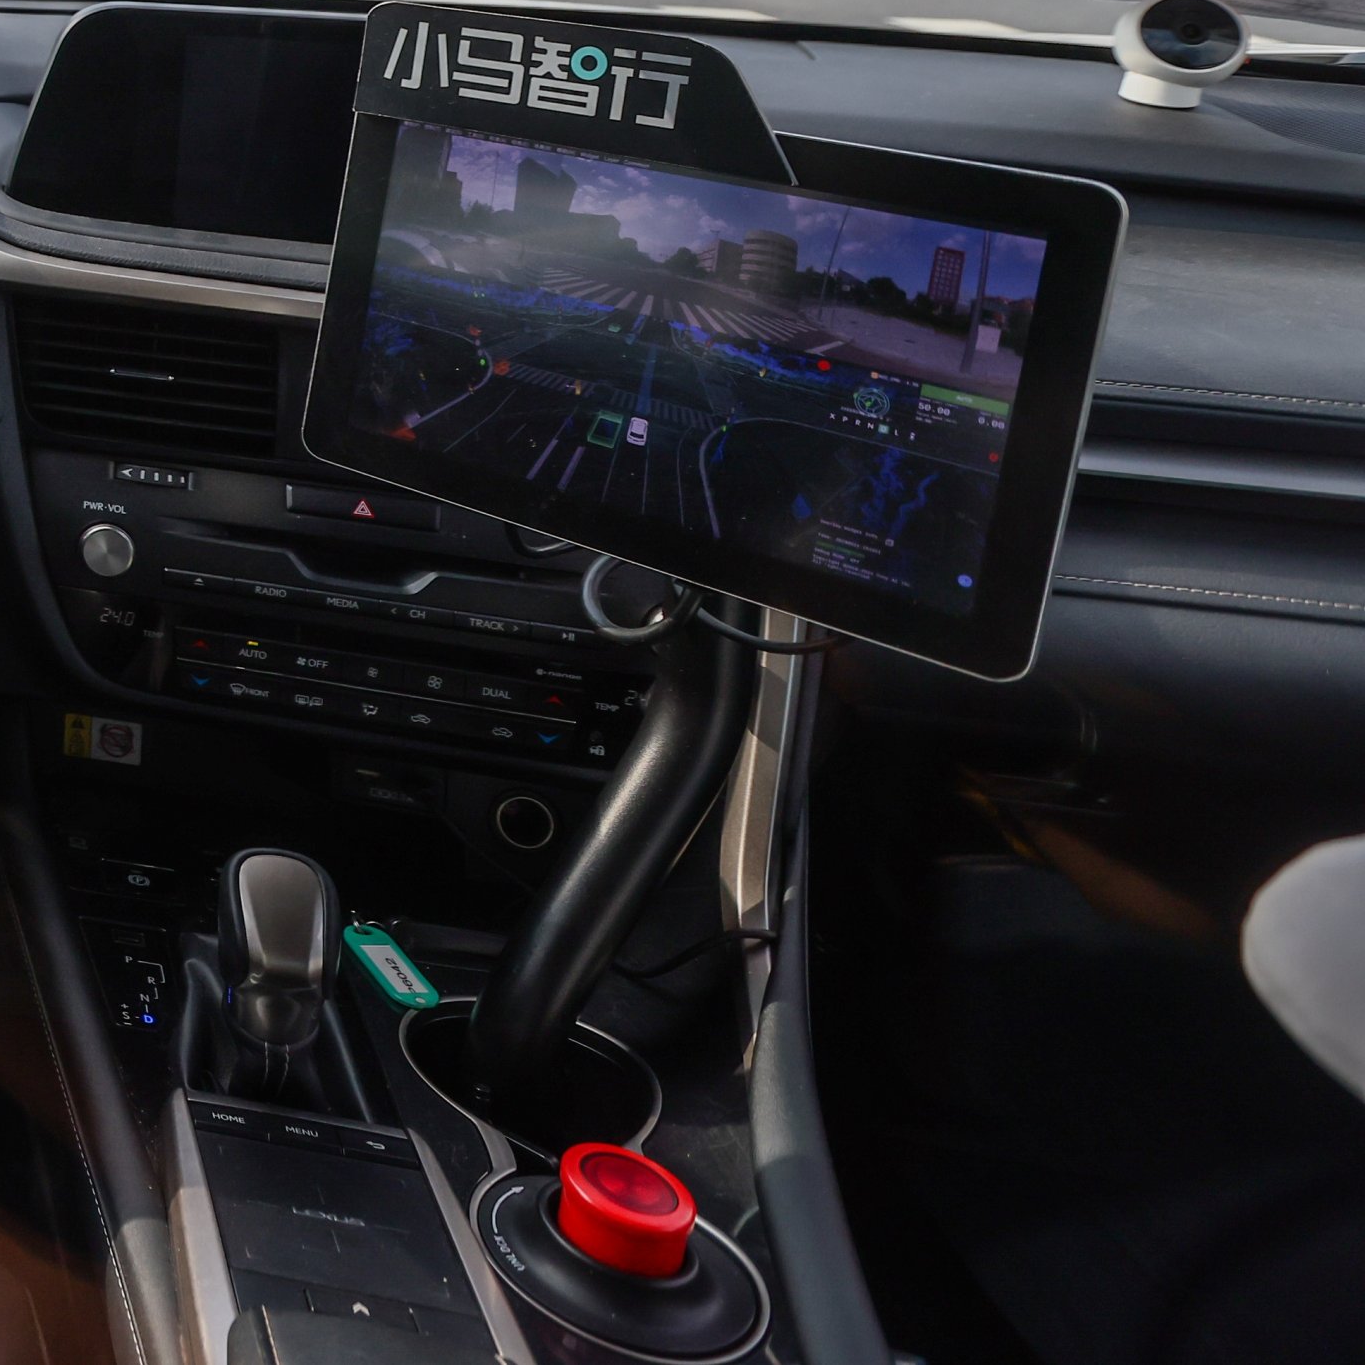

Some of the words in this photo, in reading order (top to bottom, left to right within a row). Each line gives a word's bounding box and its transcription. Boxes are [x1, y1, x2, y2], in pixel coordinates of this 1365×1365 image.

[383, 21, 692, 130] 小马智行
[255, 586, 287, 598] RADIO
[327, 597, 359, 609] MEDIA
[410, 609, 426, 620] CH
[469, 617, 505, 632] TRACK
[239, 648, 267, 659] AUTO
[308, 657, 329, 669] OFF
[245, 688, 270, 698] FRONT
[482, 687, 511, 700] DUAL
[595, 701, 620, 712] TEMP
[140, 993, 150, 1002] N
[143, 1015, 154, 1024] D
[212, 1112, 245, 1124] HOME
[285, 1125, 319, 1138] MENU
